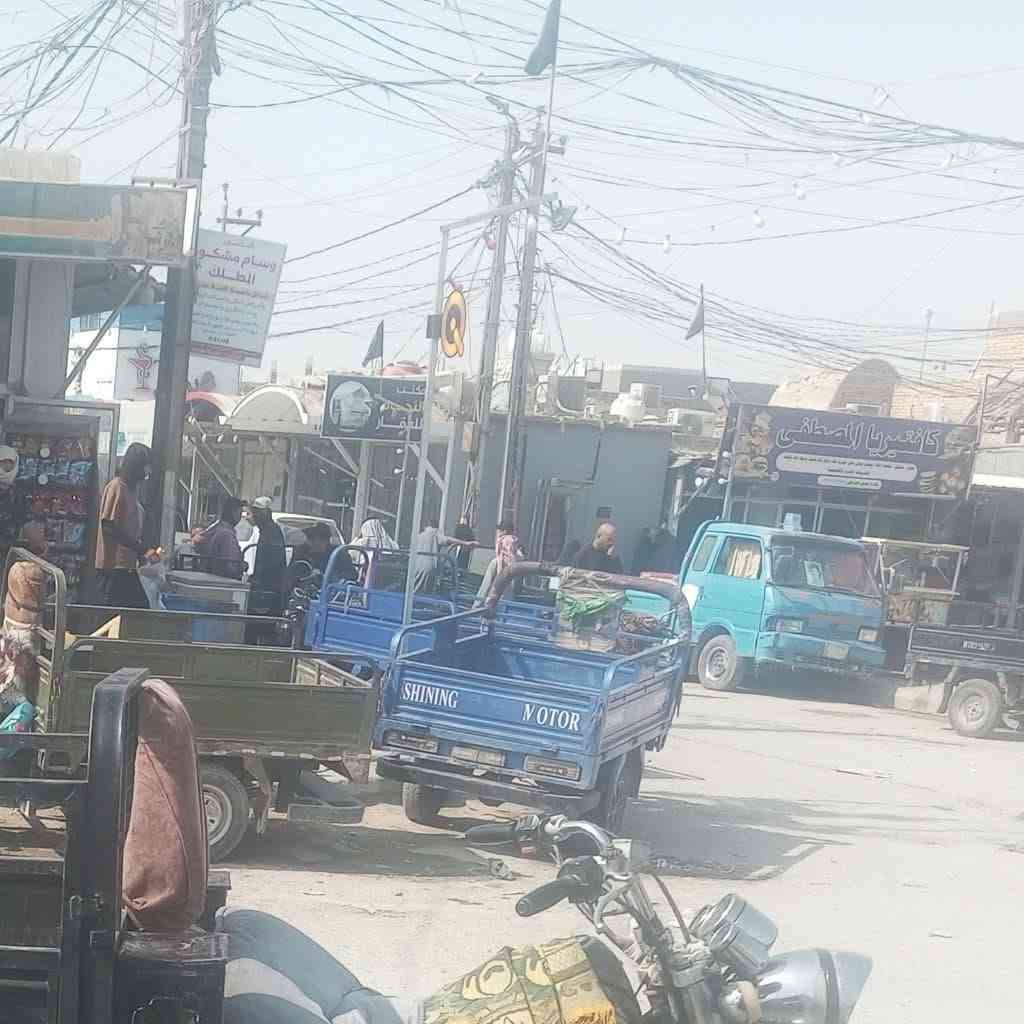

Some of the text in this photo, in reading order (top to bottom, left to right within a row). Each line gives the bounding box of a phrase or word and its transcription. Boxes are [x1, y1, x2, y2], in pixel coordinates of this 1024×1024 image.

[197, 246, 277, 273] وسام مشكو
[403, 681, 459, 709] SHINING
